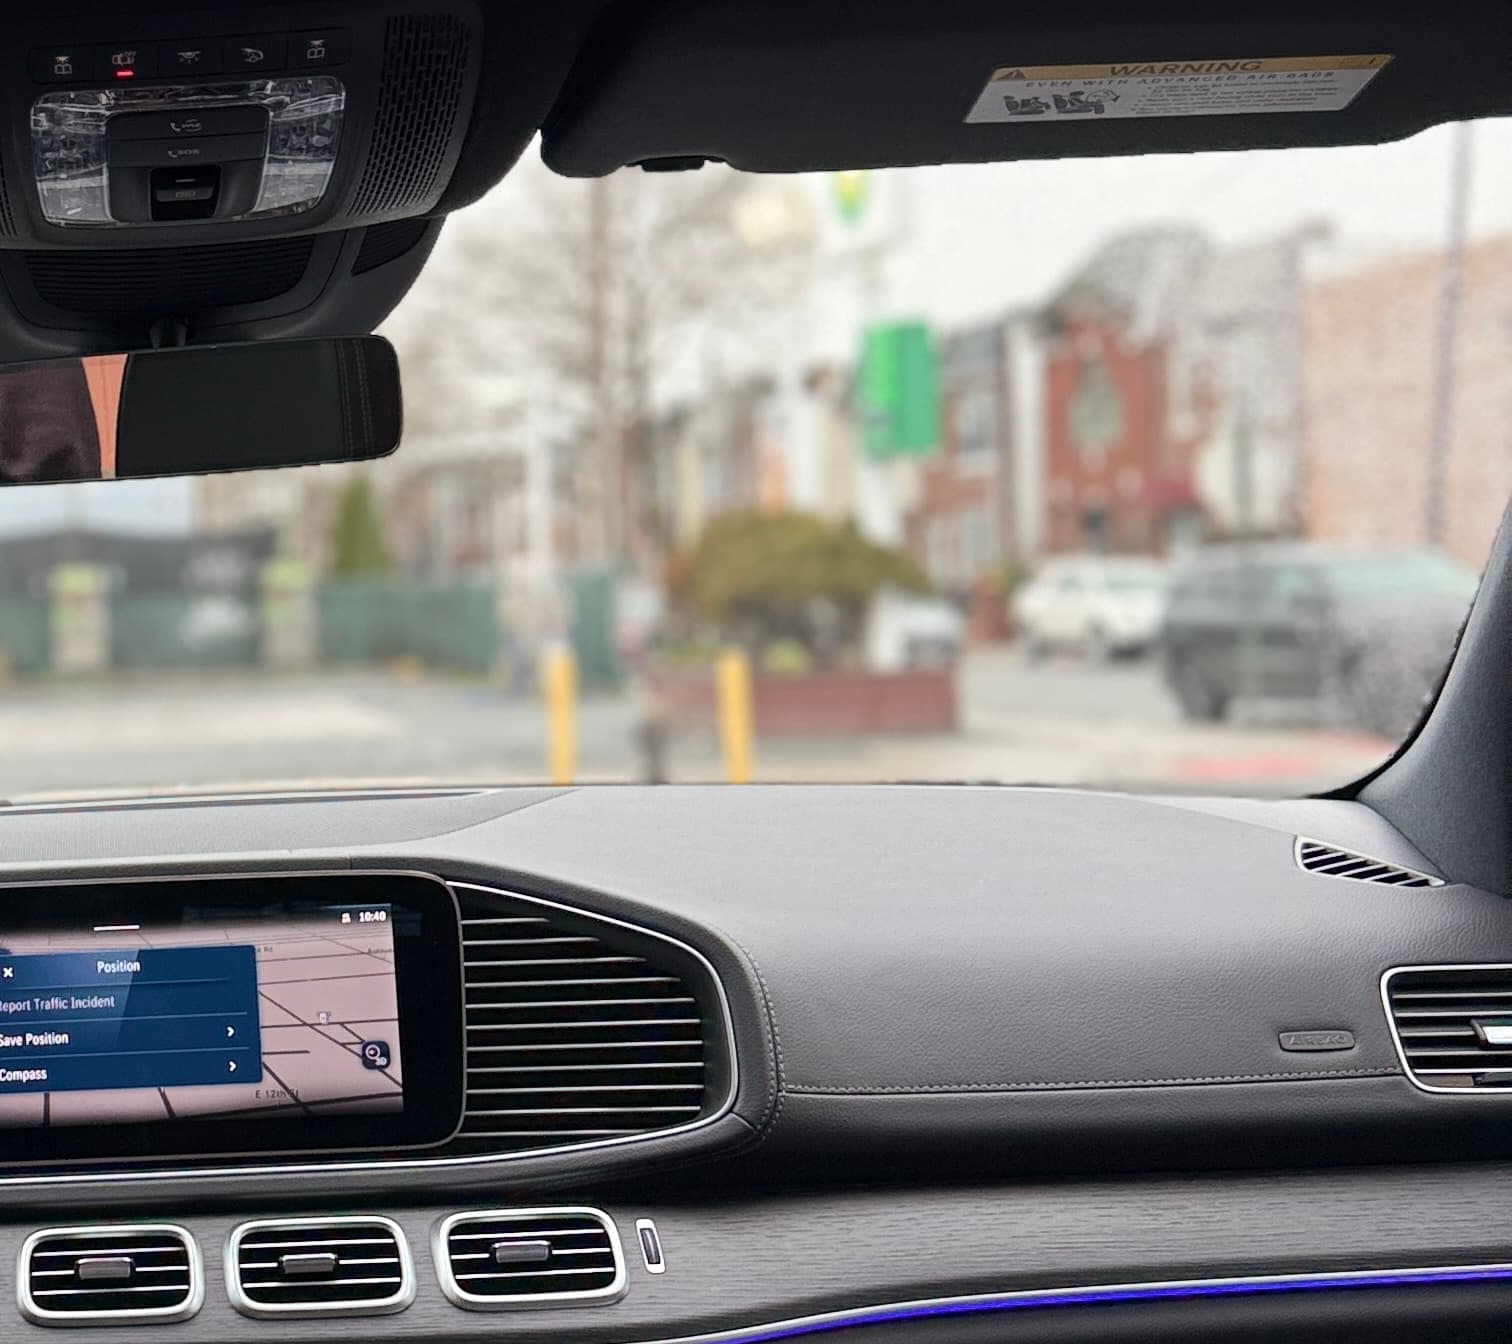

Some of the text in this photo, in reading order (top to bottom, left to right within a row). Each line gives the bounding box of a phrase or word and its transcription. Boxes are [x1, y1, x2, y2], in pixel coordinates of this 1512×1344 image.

[1109, 61, 1263, 76] WARNING
[97, 959, 141, 974] Position
[33, 997, 69, 1011] Traffic
[70, 995, 116, 1010] Incident
[26, 1031, 69, 1047] Position
[256, 1089, 261, 1099] E
[265, 1089, 286, 1099] 12th
